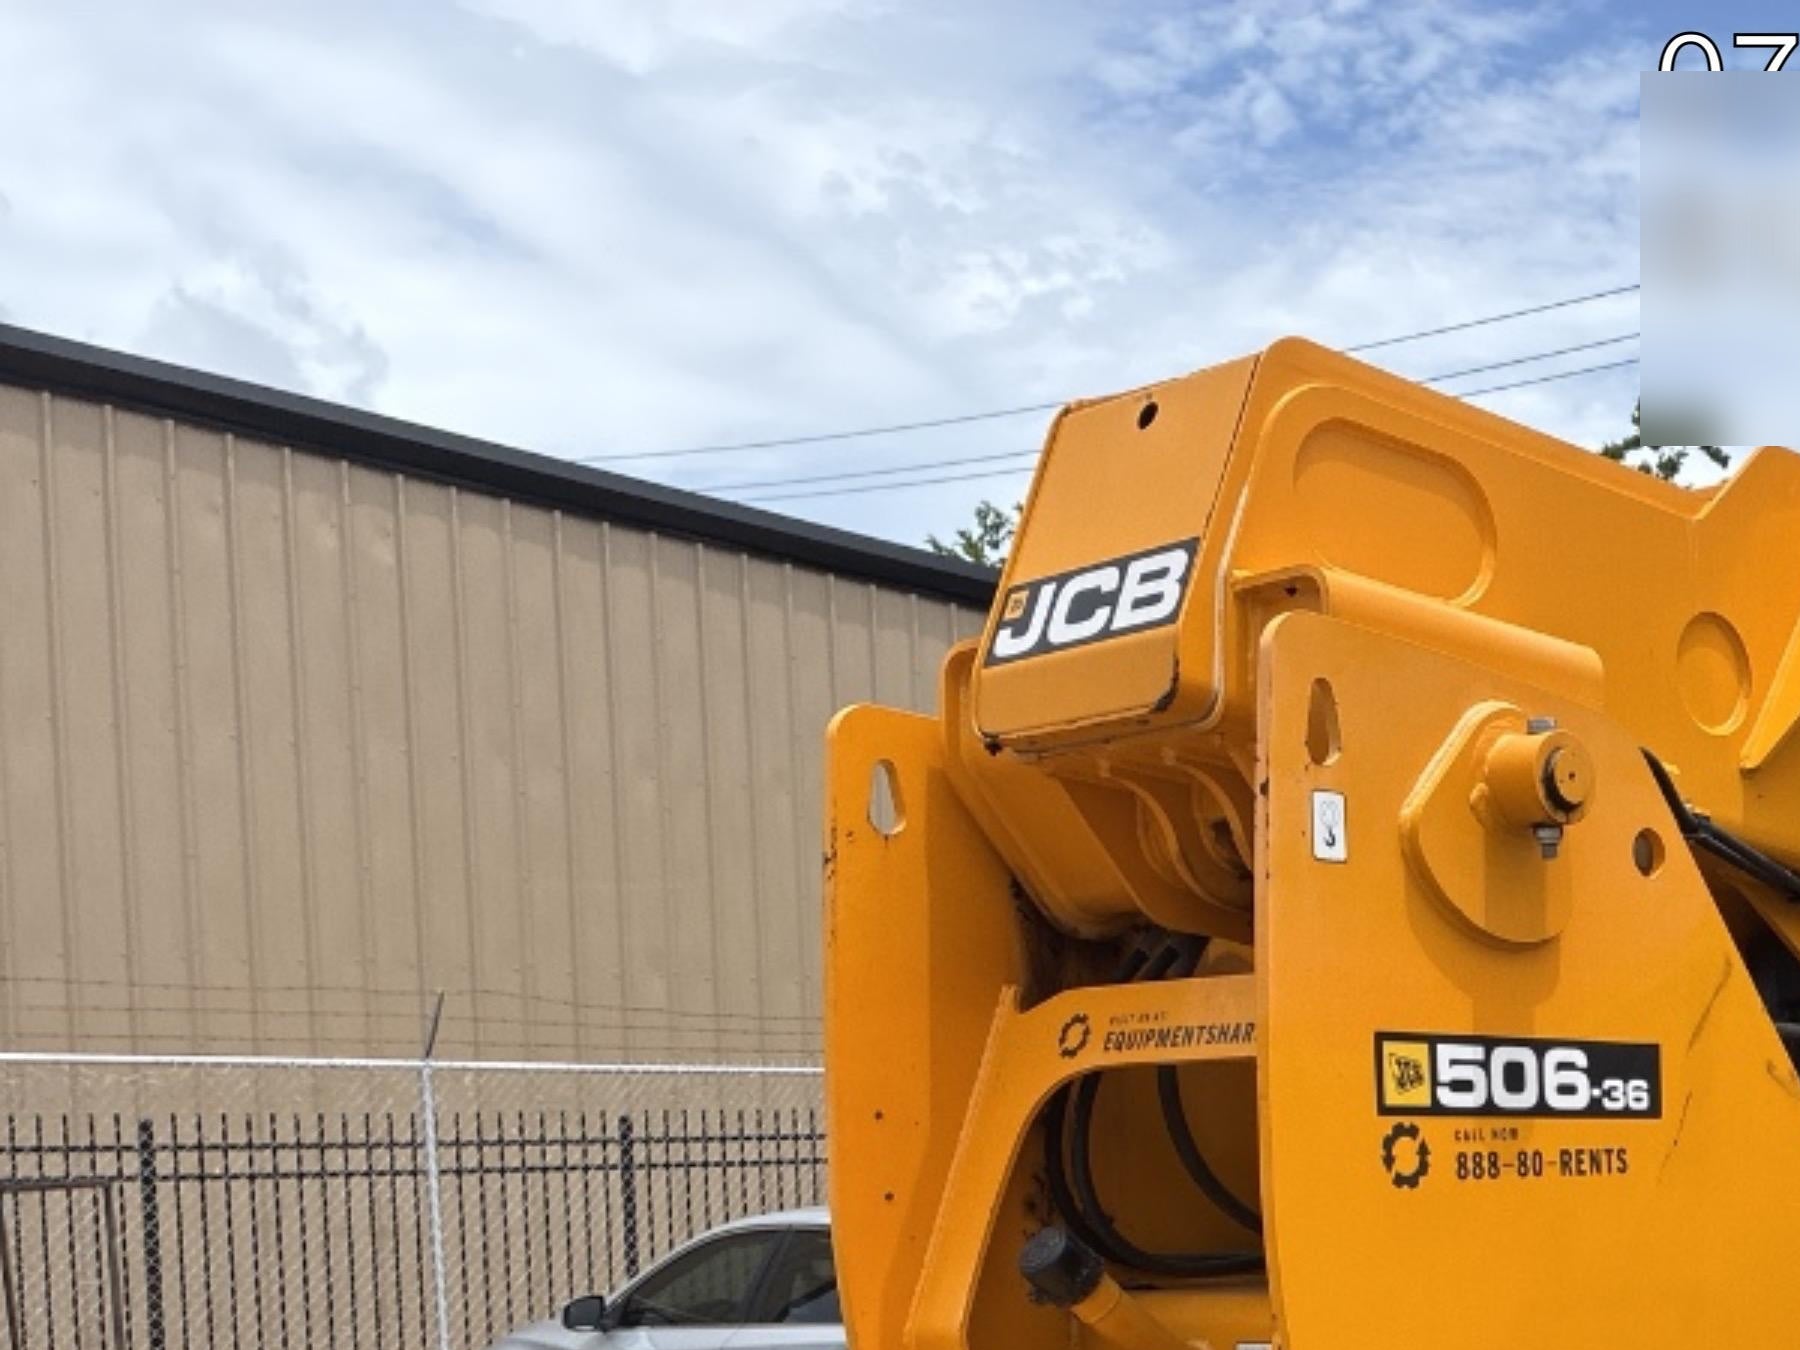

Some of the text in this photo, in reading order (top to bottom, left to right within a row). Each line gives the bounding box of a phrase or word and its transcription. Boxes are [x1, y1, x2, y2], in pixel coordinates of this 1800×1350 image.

[992, 548, 1189, 658] JCB
[1103, 1022, 1258, 1052] EQUIPMENTSHAR
[1435, 1043, 1650, 1111] 506-36
[1456, 1147, 1628, 1180] 888-80-RENTS
